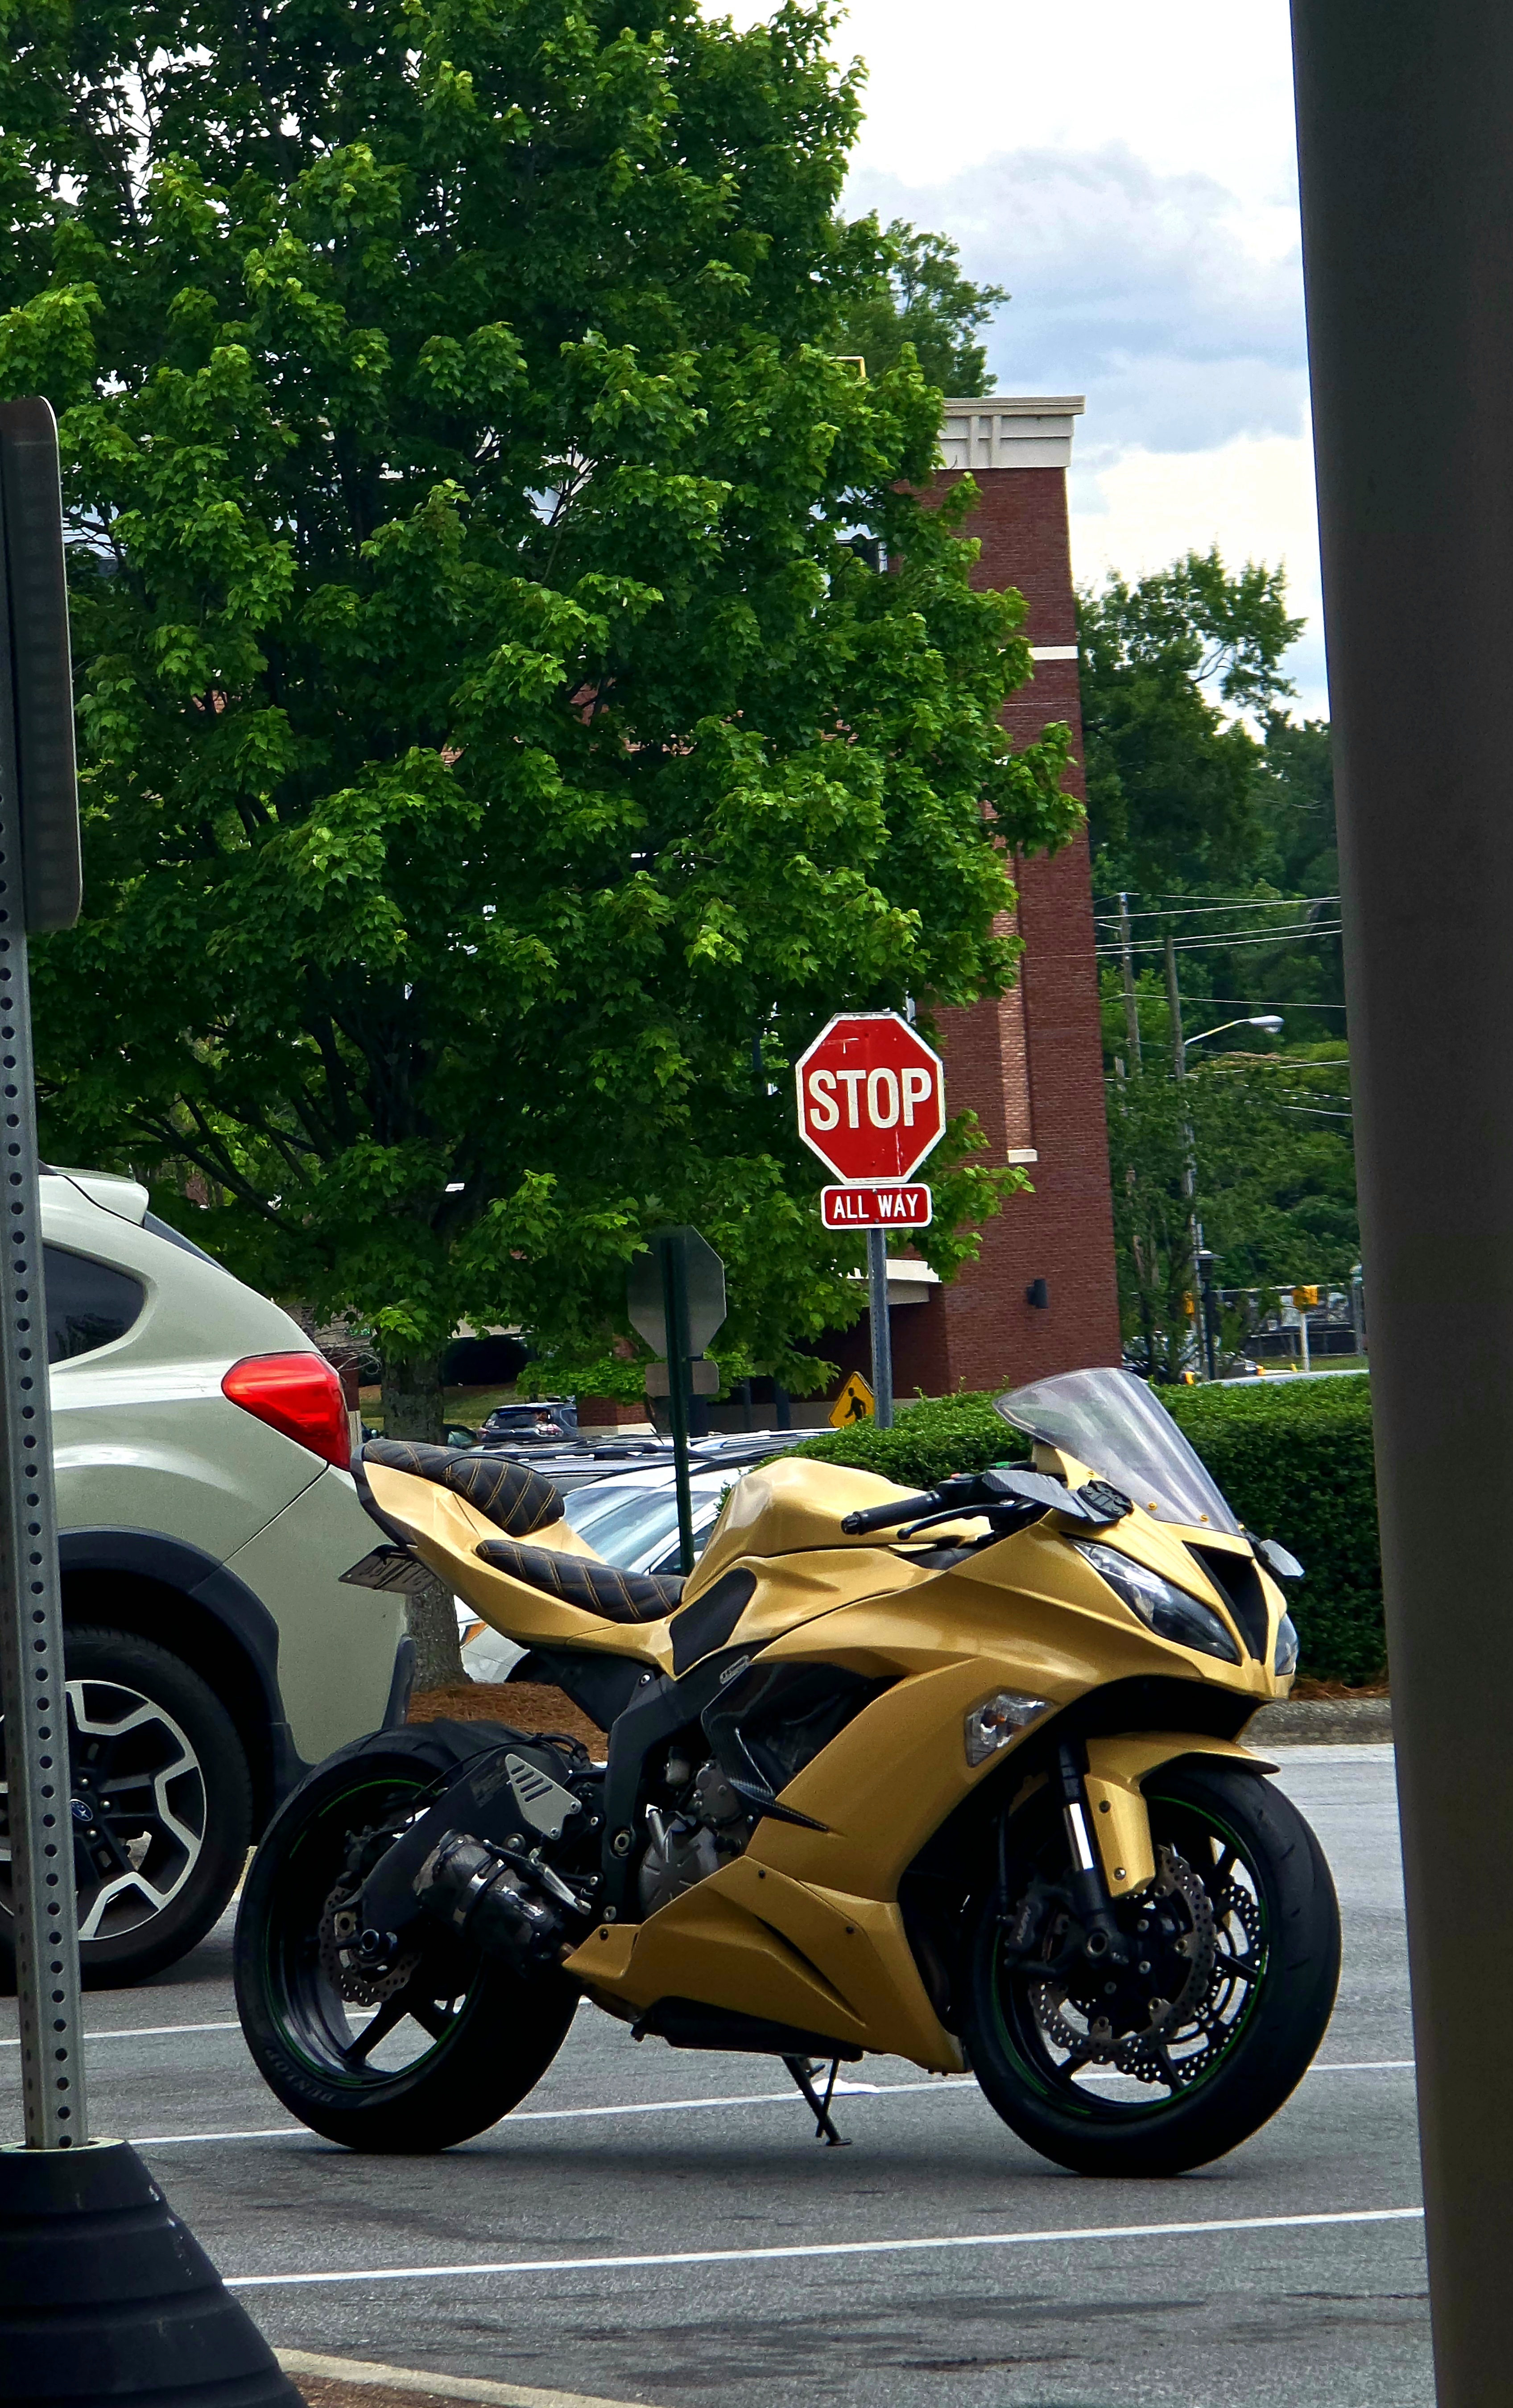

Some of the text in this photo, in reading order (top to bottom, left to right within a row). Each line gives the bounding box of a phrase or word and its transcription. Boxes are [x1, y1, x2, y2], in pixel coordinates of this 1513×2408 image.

[809, 1068, 932, 1131] STOP
[833, 1194, 918, 1219] ALL WAY
[264, 2047, 337, 2103] DUNLOP
